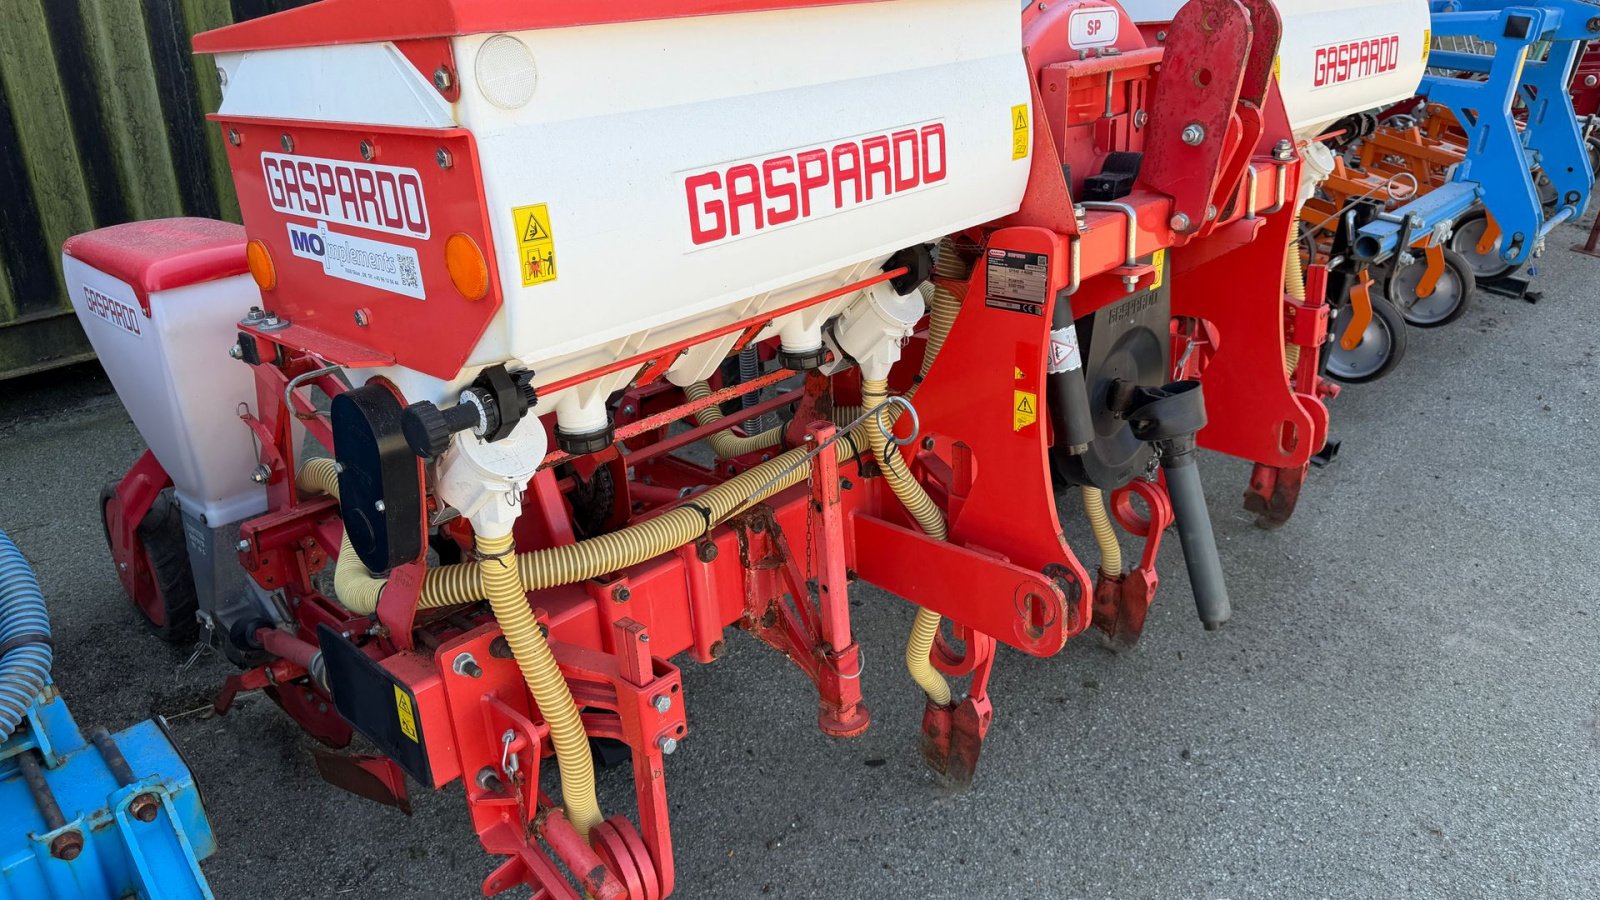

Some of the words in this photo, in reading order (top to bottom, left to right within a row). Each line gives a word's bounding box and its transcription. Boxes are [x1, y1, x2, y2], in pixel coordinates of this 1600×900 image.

[1087, 19, 1102, 36] SP
[1313, 35, 1399, 87] GASPARDO
[263, 157, 427, 234] GASPARDO
[684, 122, 947, 245] GASPARDO
[290, 229, 325, 256] MO
[83, 286, 141, 335] GASPARDO
